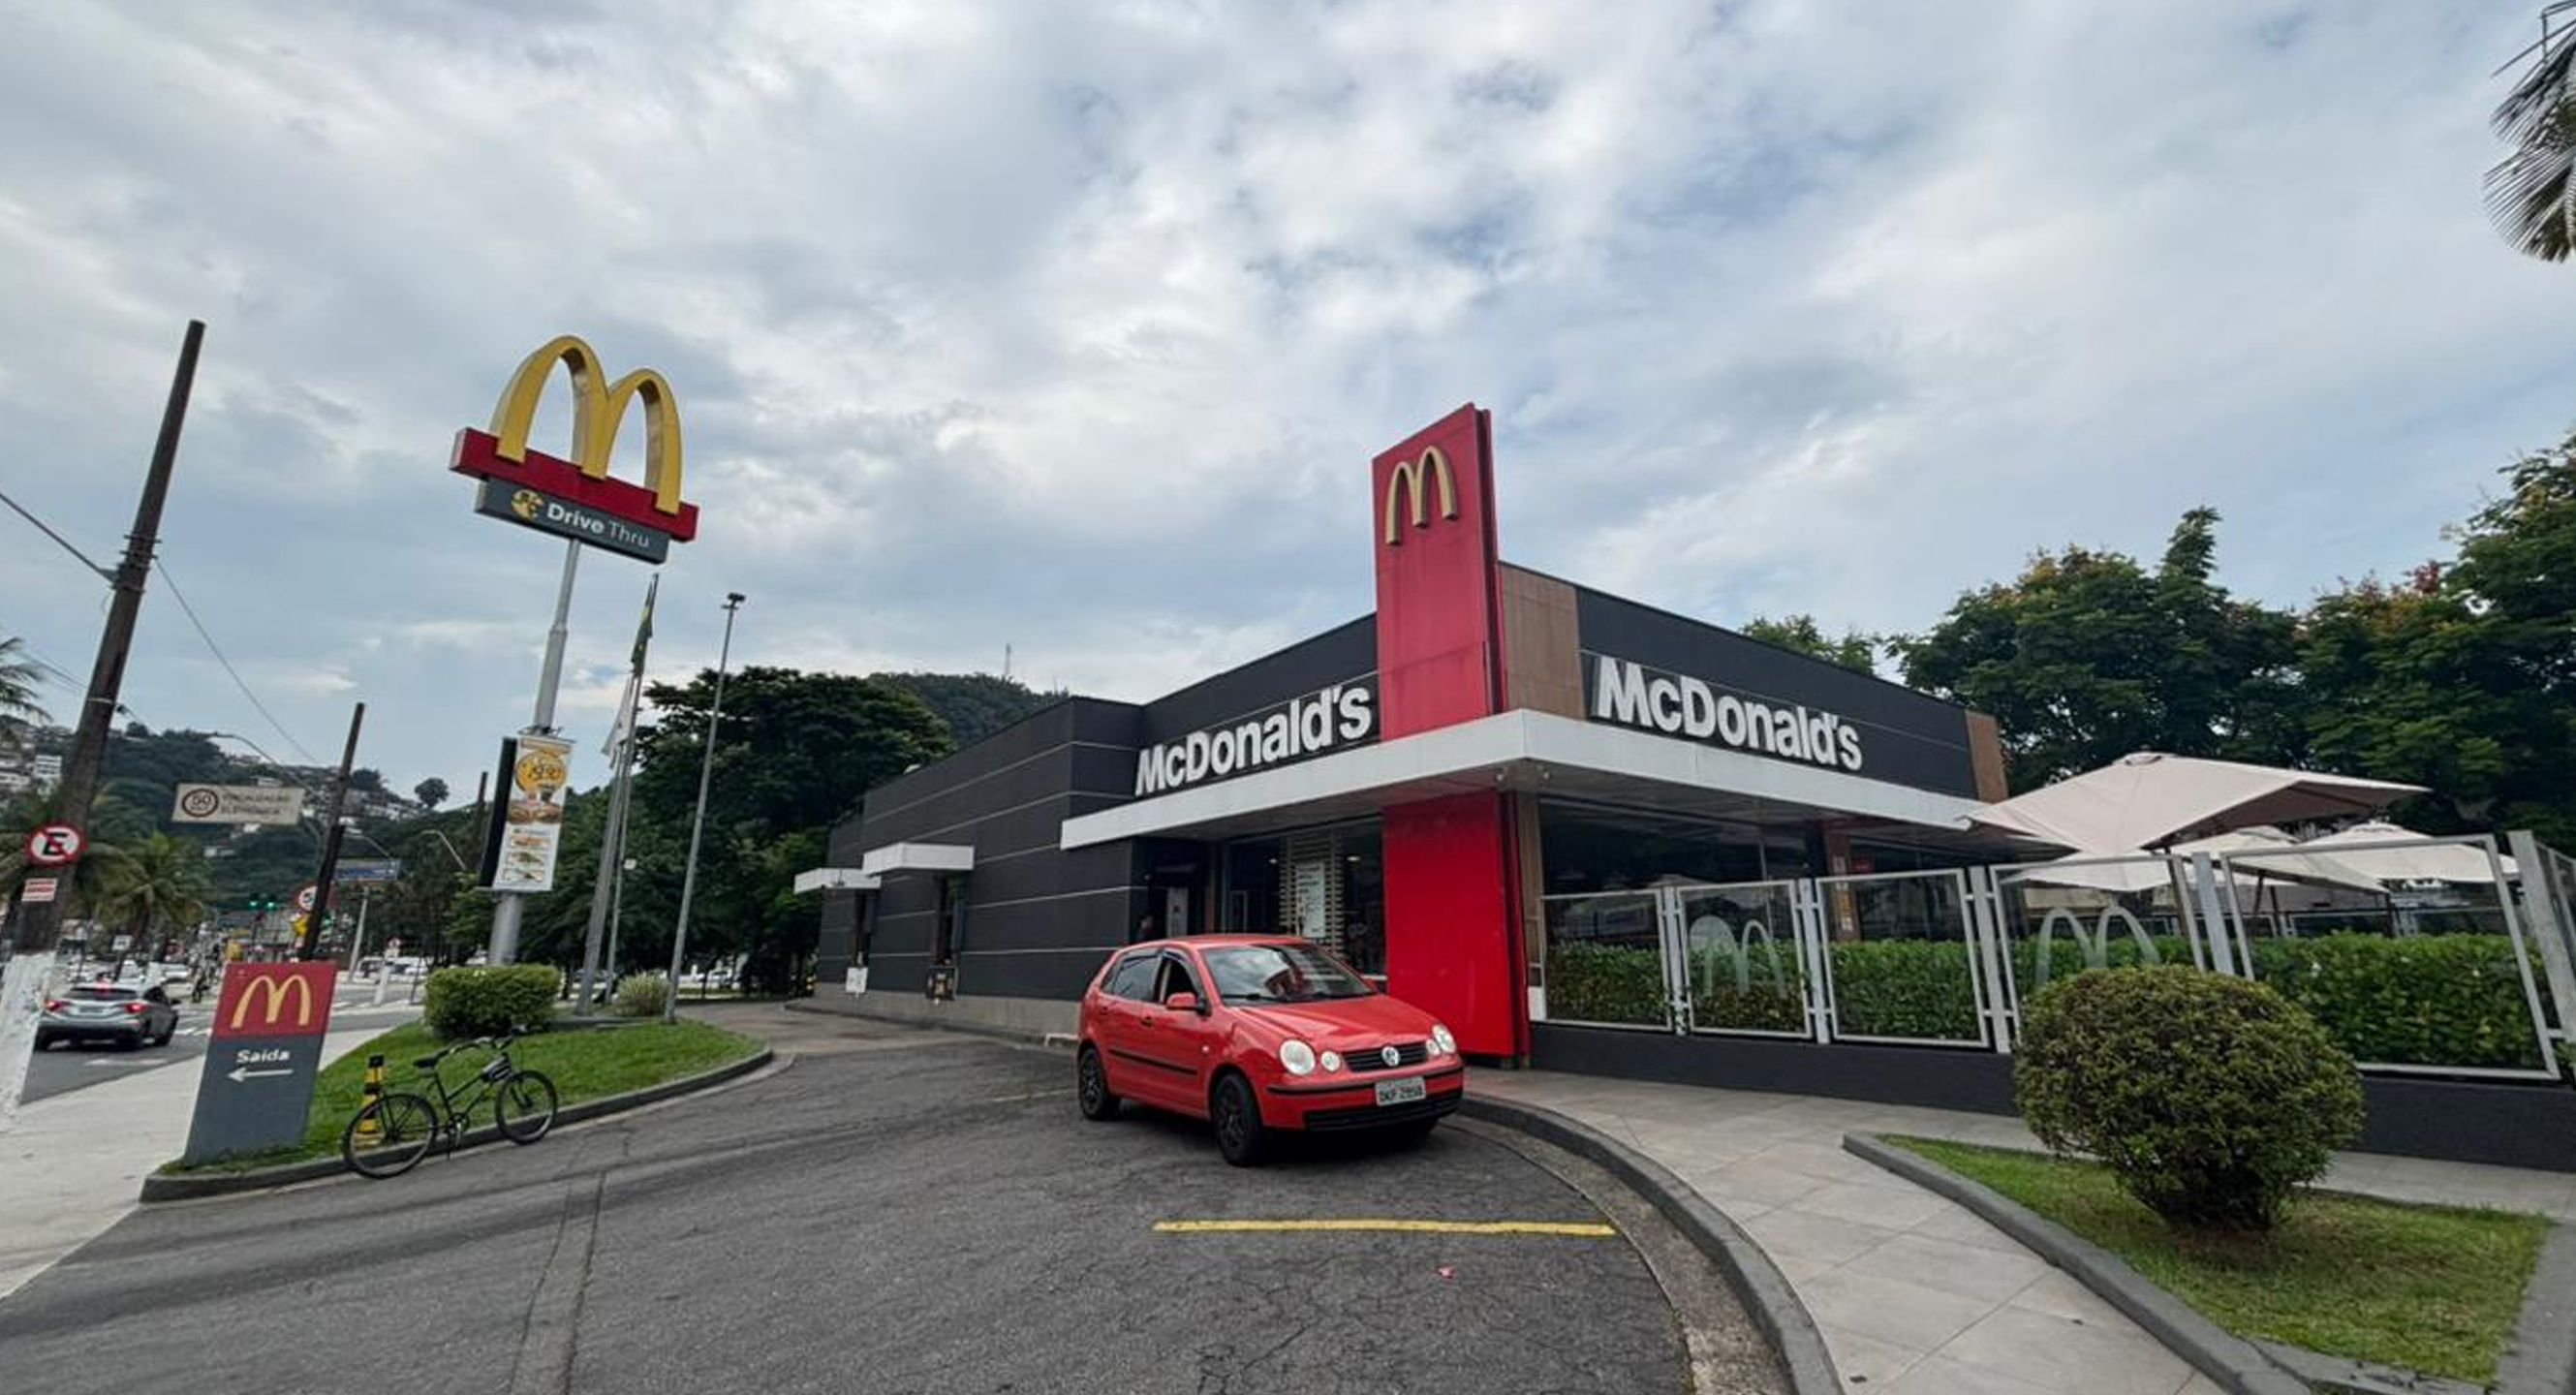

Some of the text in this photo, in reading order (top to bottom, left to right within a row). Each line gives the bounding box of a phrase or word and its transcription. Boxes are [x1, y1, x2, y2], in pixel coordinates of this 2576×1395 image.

[545, 502, 650, 548] Drive Thru
[1134, 684, 1372, 797] McDonald's
[1597, 655, 1863, 771] McDonald's
